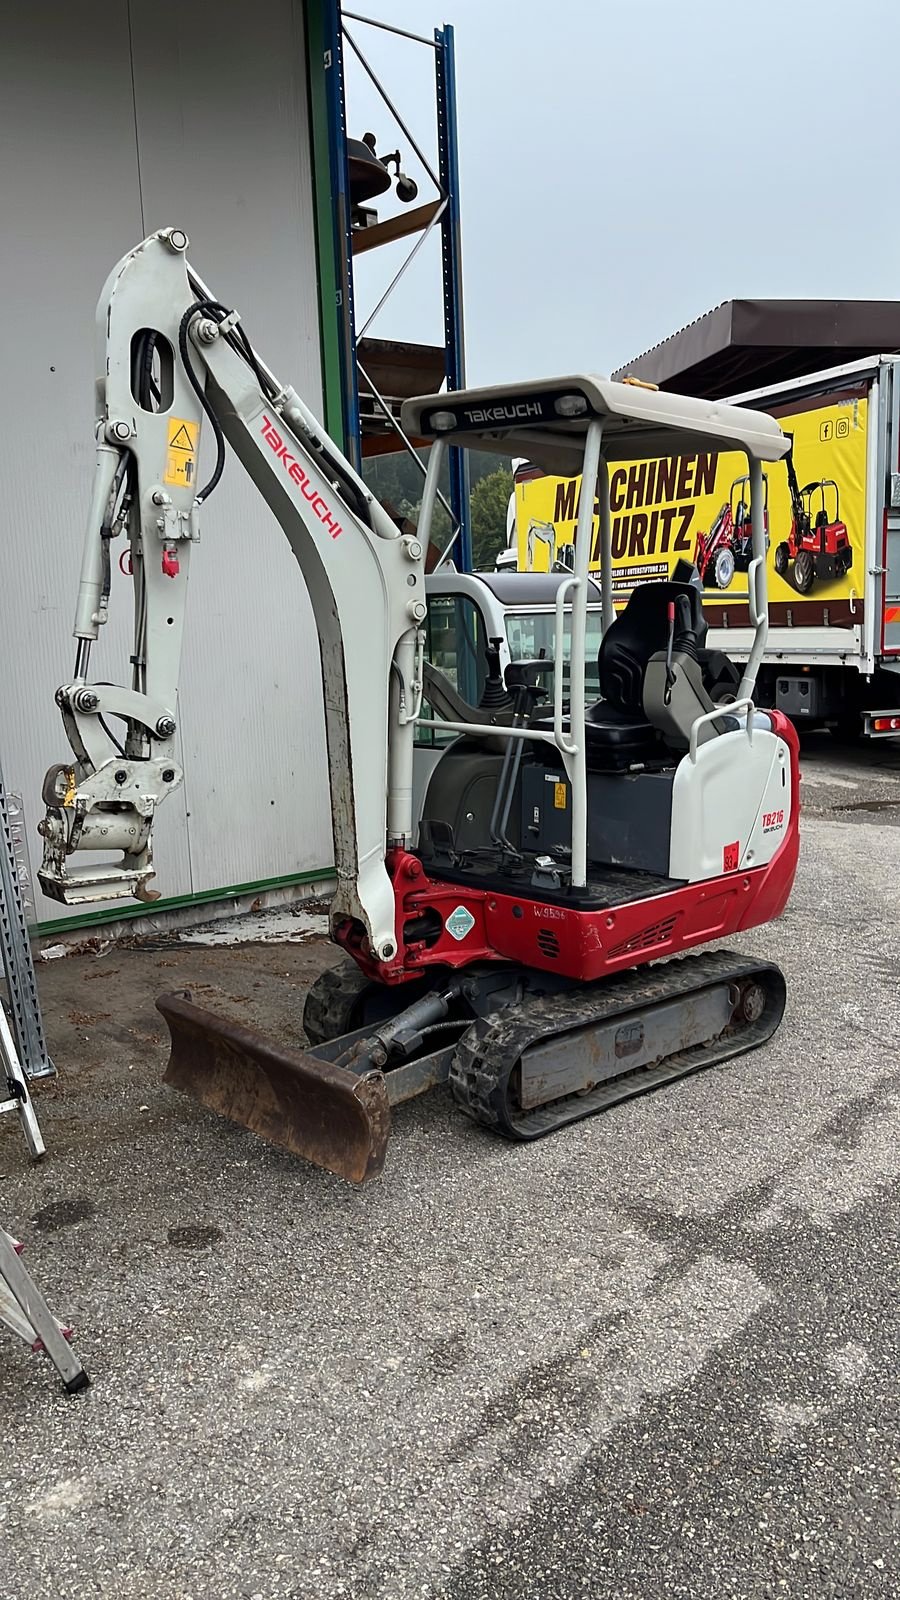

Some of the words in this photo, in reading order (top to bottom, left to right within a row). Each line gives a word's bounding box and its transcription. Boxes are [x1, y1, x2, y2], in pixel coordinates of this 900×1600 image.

[463, 402, 543, 423] TAKEUCHI
[260, 415, 343, 539] TAKEUCHI
[762, 809, 784, 828] TB216
